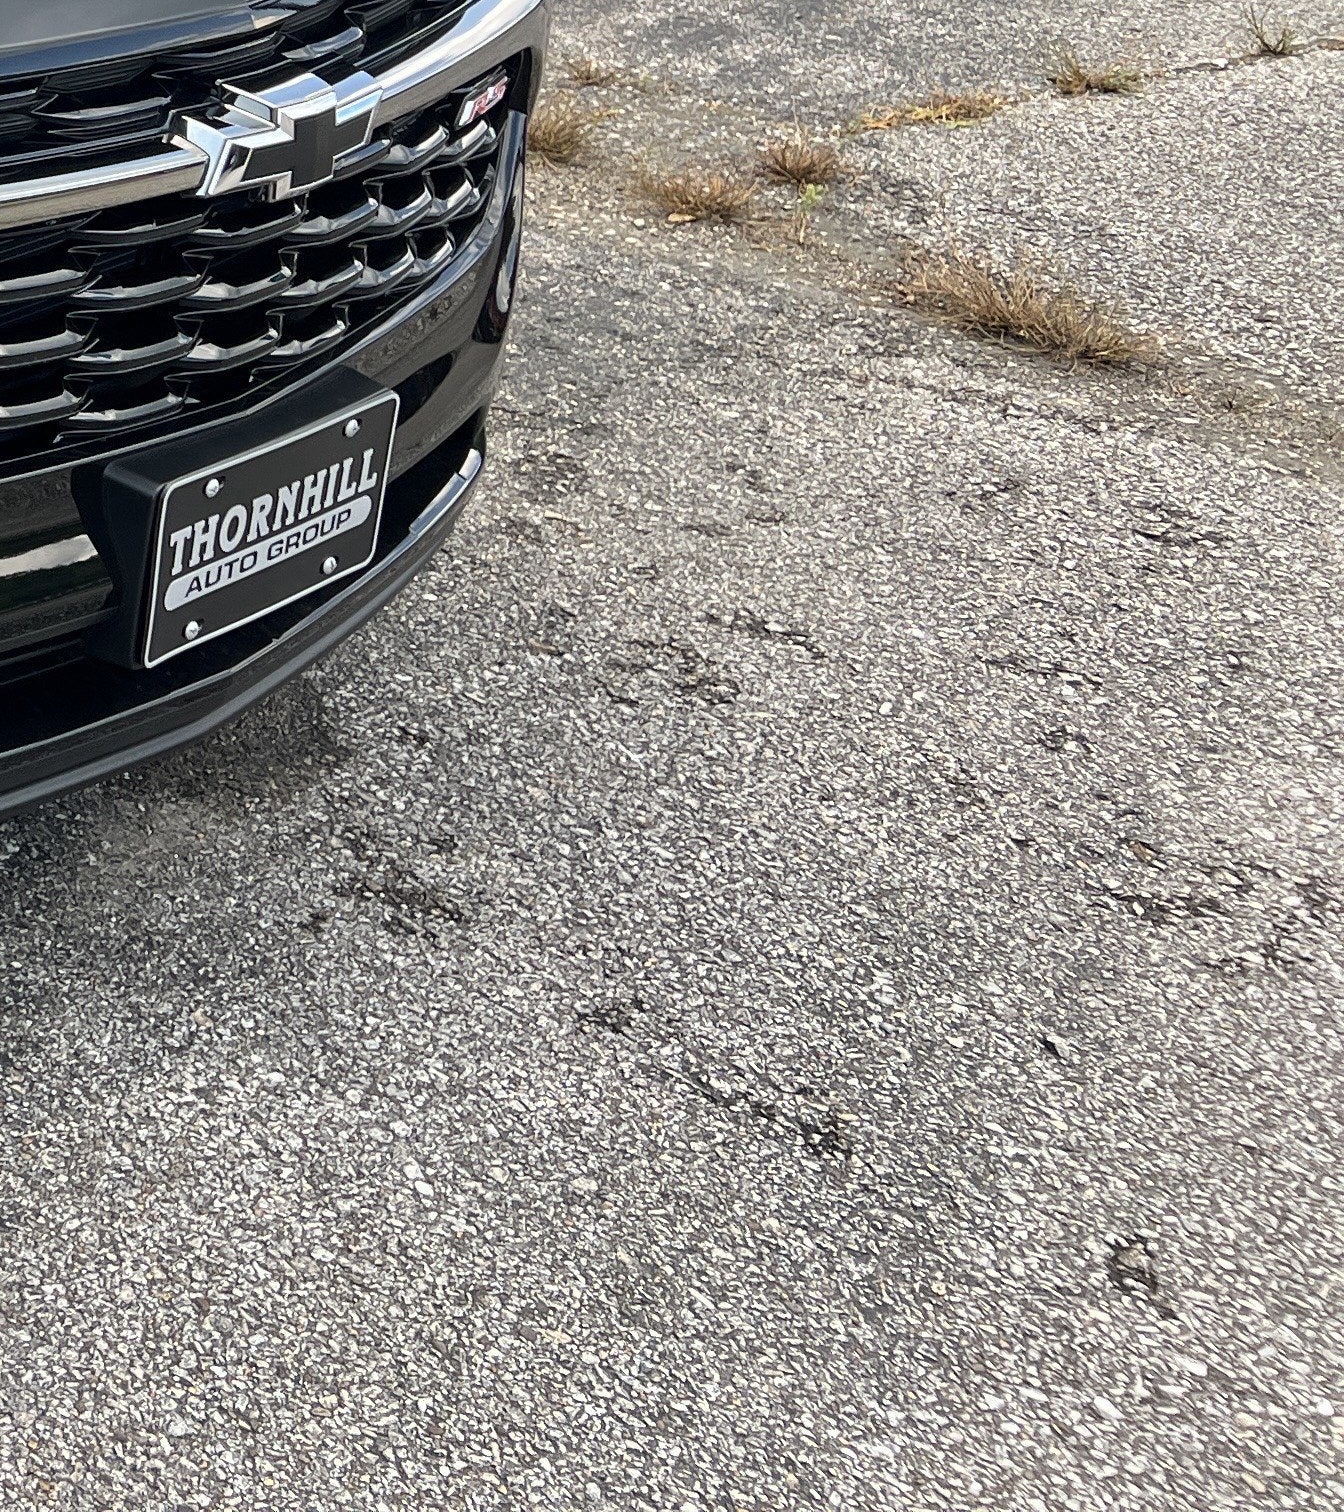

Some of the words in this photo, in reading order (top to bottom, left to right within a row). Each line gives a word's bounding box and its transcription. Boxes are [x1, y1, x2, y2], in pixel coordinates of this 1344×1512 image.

[169, 447, 378, 576] THORNHILL
[184, 550, 258, 599] AUTO
[266, 507, 352, 562] GROUP
